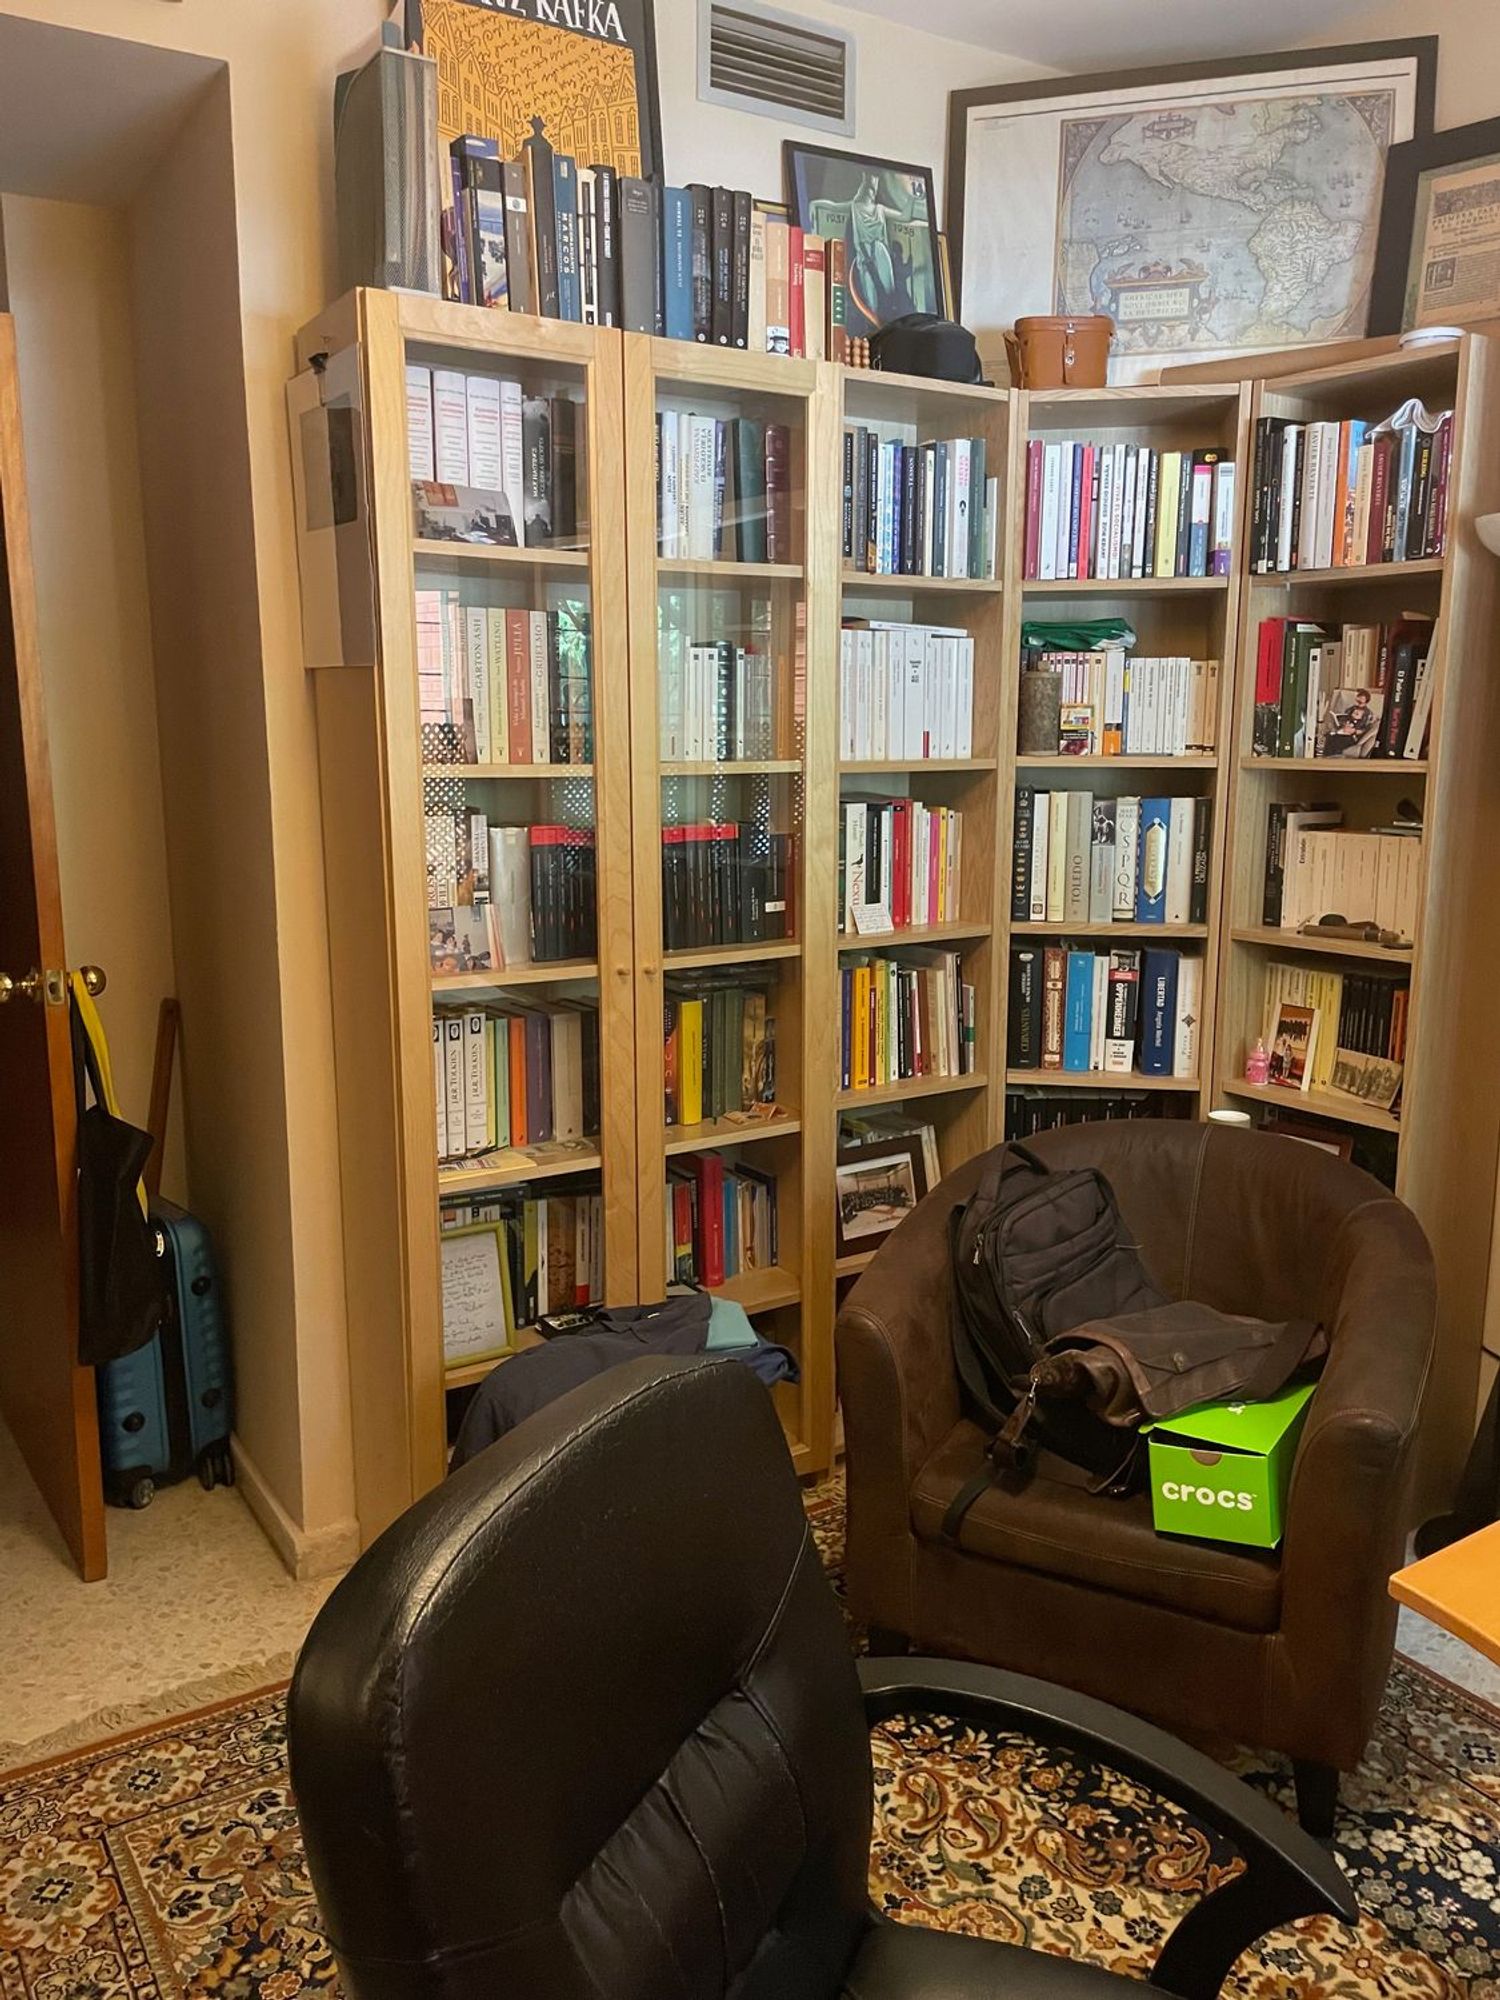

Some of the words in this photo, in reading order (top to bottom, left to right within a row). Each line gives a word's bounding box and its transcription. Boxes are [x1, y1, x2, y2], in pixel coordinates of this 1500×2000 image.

[536, 0, 627, 42] KAFKA
[561, 212, 570, 274] MARCOS
[474, 643, 482, 689] GARTON
[852, 871, 863, 908] Nexu
[1072, 854, 1084, 905] TOLEDO
[1112, 982, 1124, 1037] OPPENHEIMER
[1156, 976, 1166, 1008] LIBERTAD
[1020, 1008, 1031, 1052] CERVANTES
[1162, 1482, 1253, 1511] crocs
